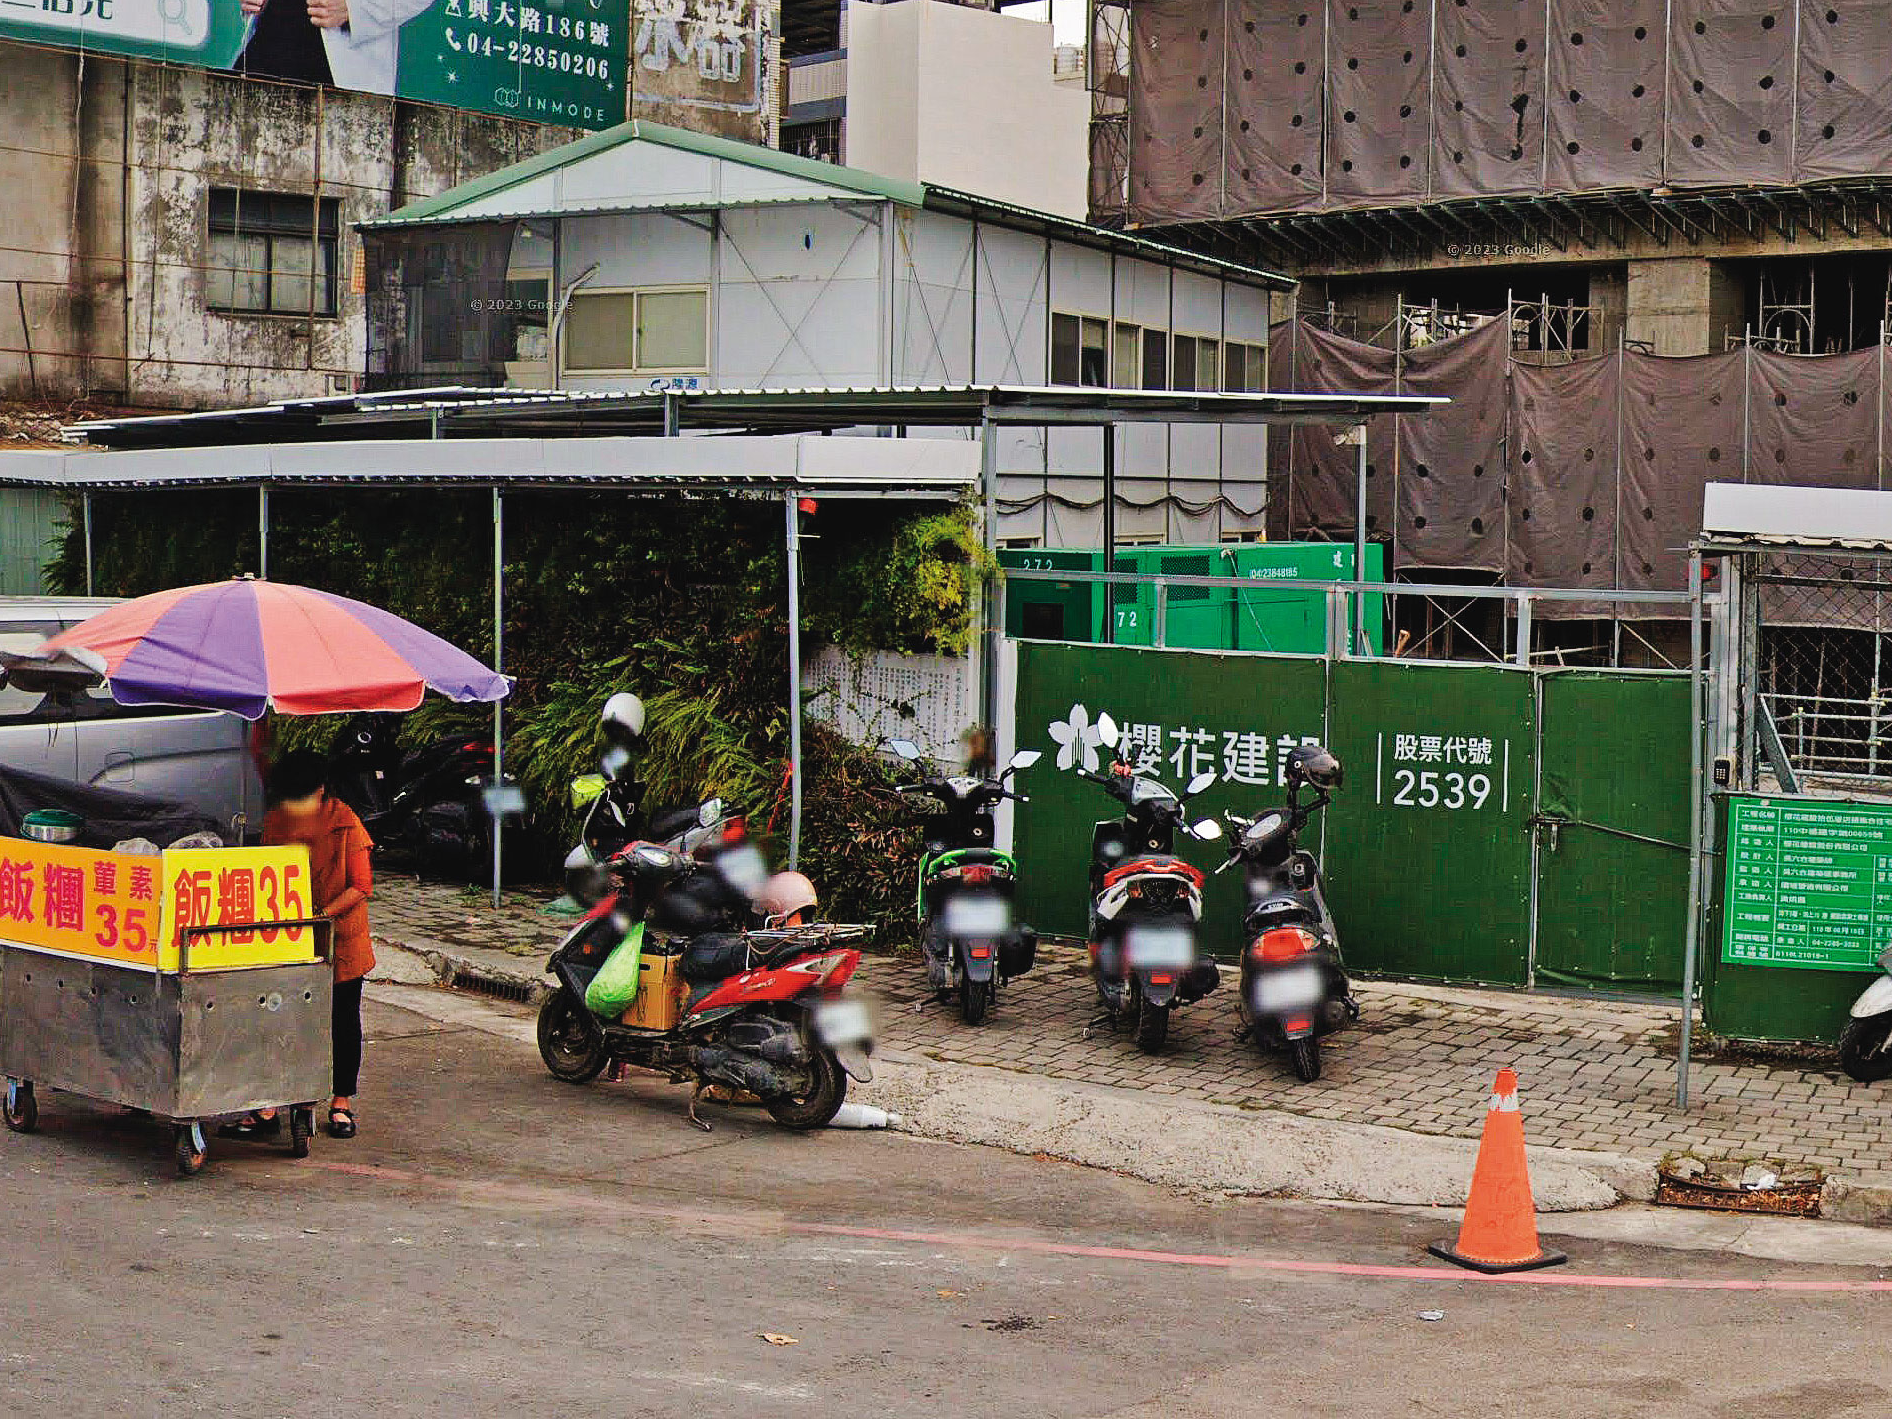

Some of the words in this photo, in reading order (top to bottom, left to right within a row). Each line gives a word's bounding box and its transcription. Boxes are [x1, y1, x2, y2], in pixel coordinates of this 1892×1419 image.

[468, 34, 609, 81] 04-22850206
[526, 95, 605, 122] INMODE
[1393, 733, 1493, 766] 股票代號
[1393, 769, 1492, 811] 2539
